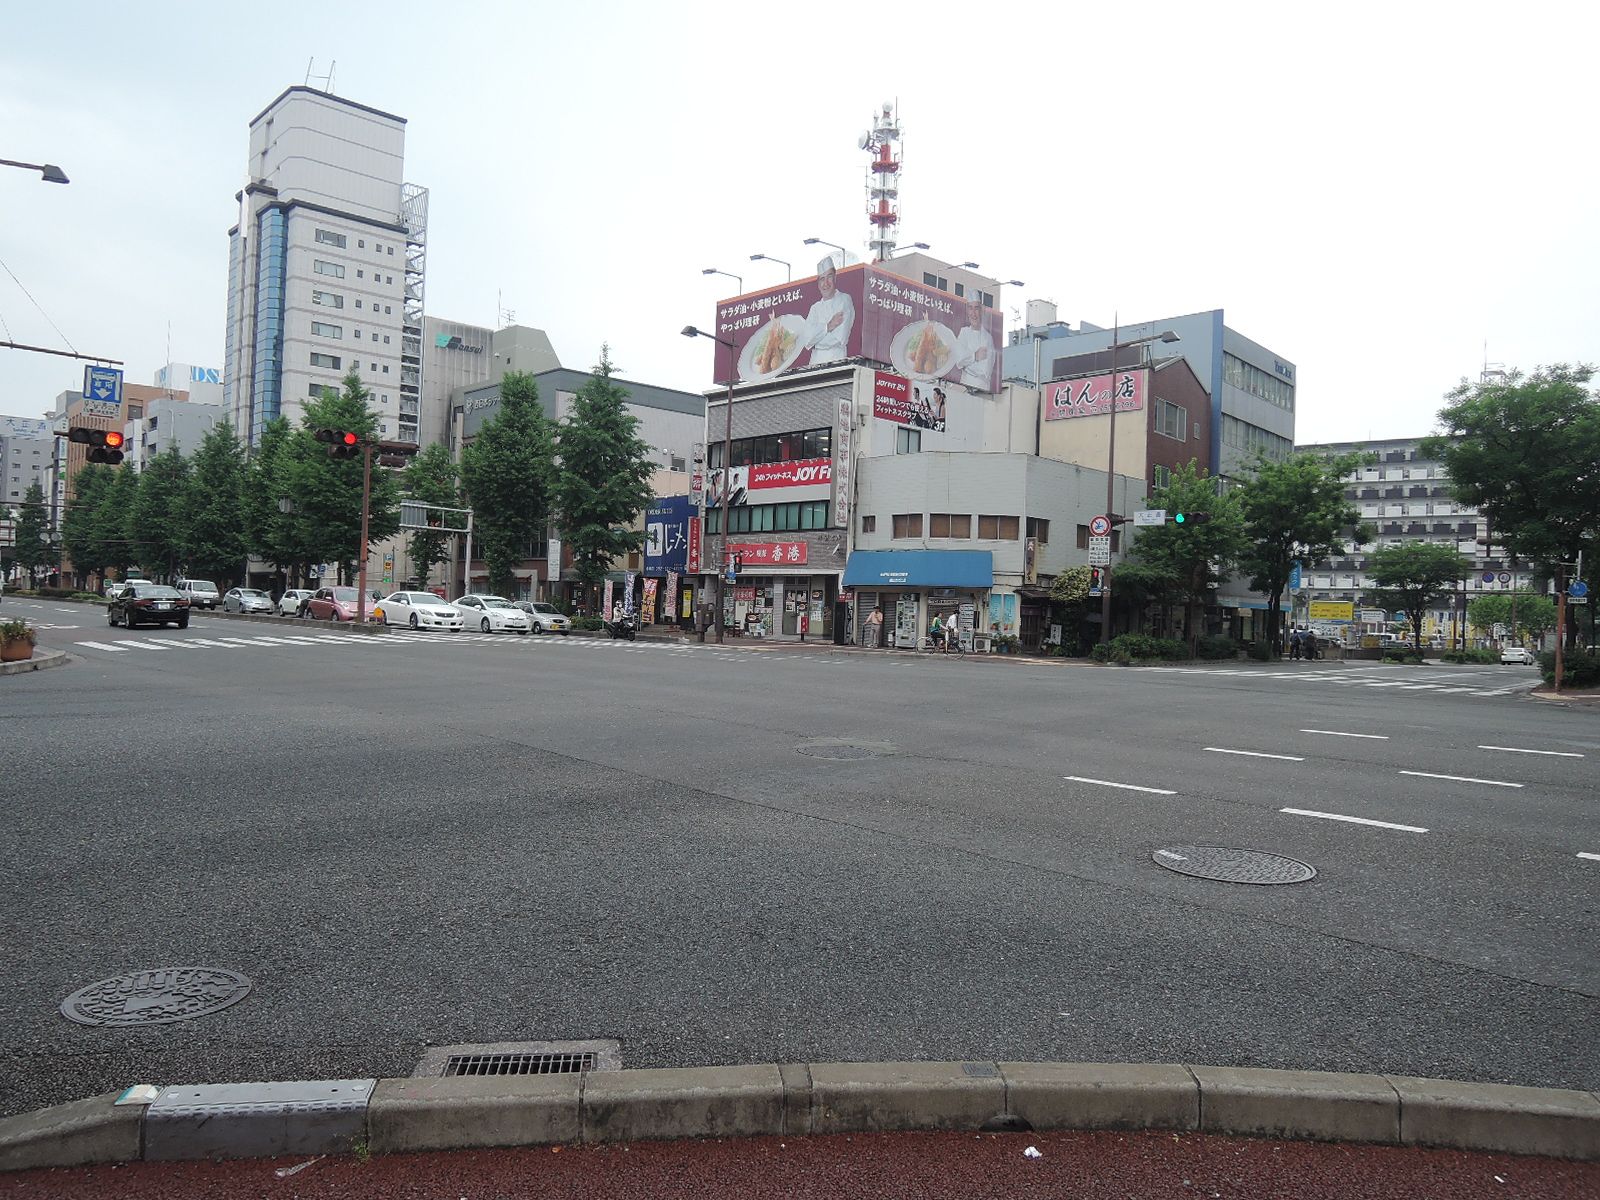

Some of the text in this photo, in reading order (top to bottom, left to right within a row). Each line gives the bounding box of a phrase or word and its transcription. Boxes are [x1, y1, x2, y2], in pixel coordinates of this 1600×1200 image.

[1053, 374, 1135, 408] はんの店
[771, 544, 800, 561] 香港
